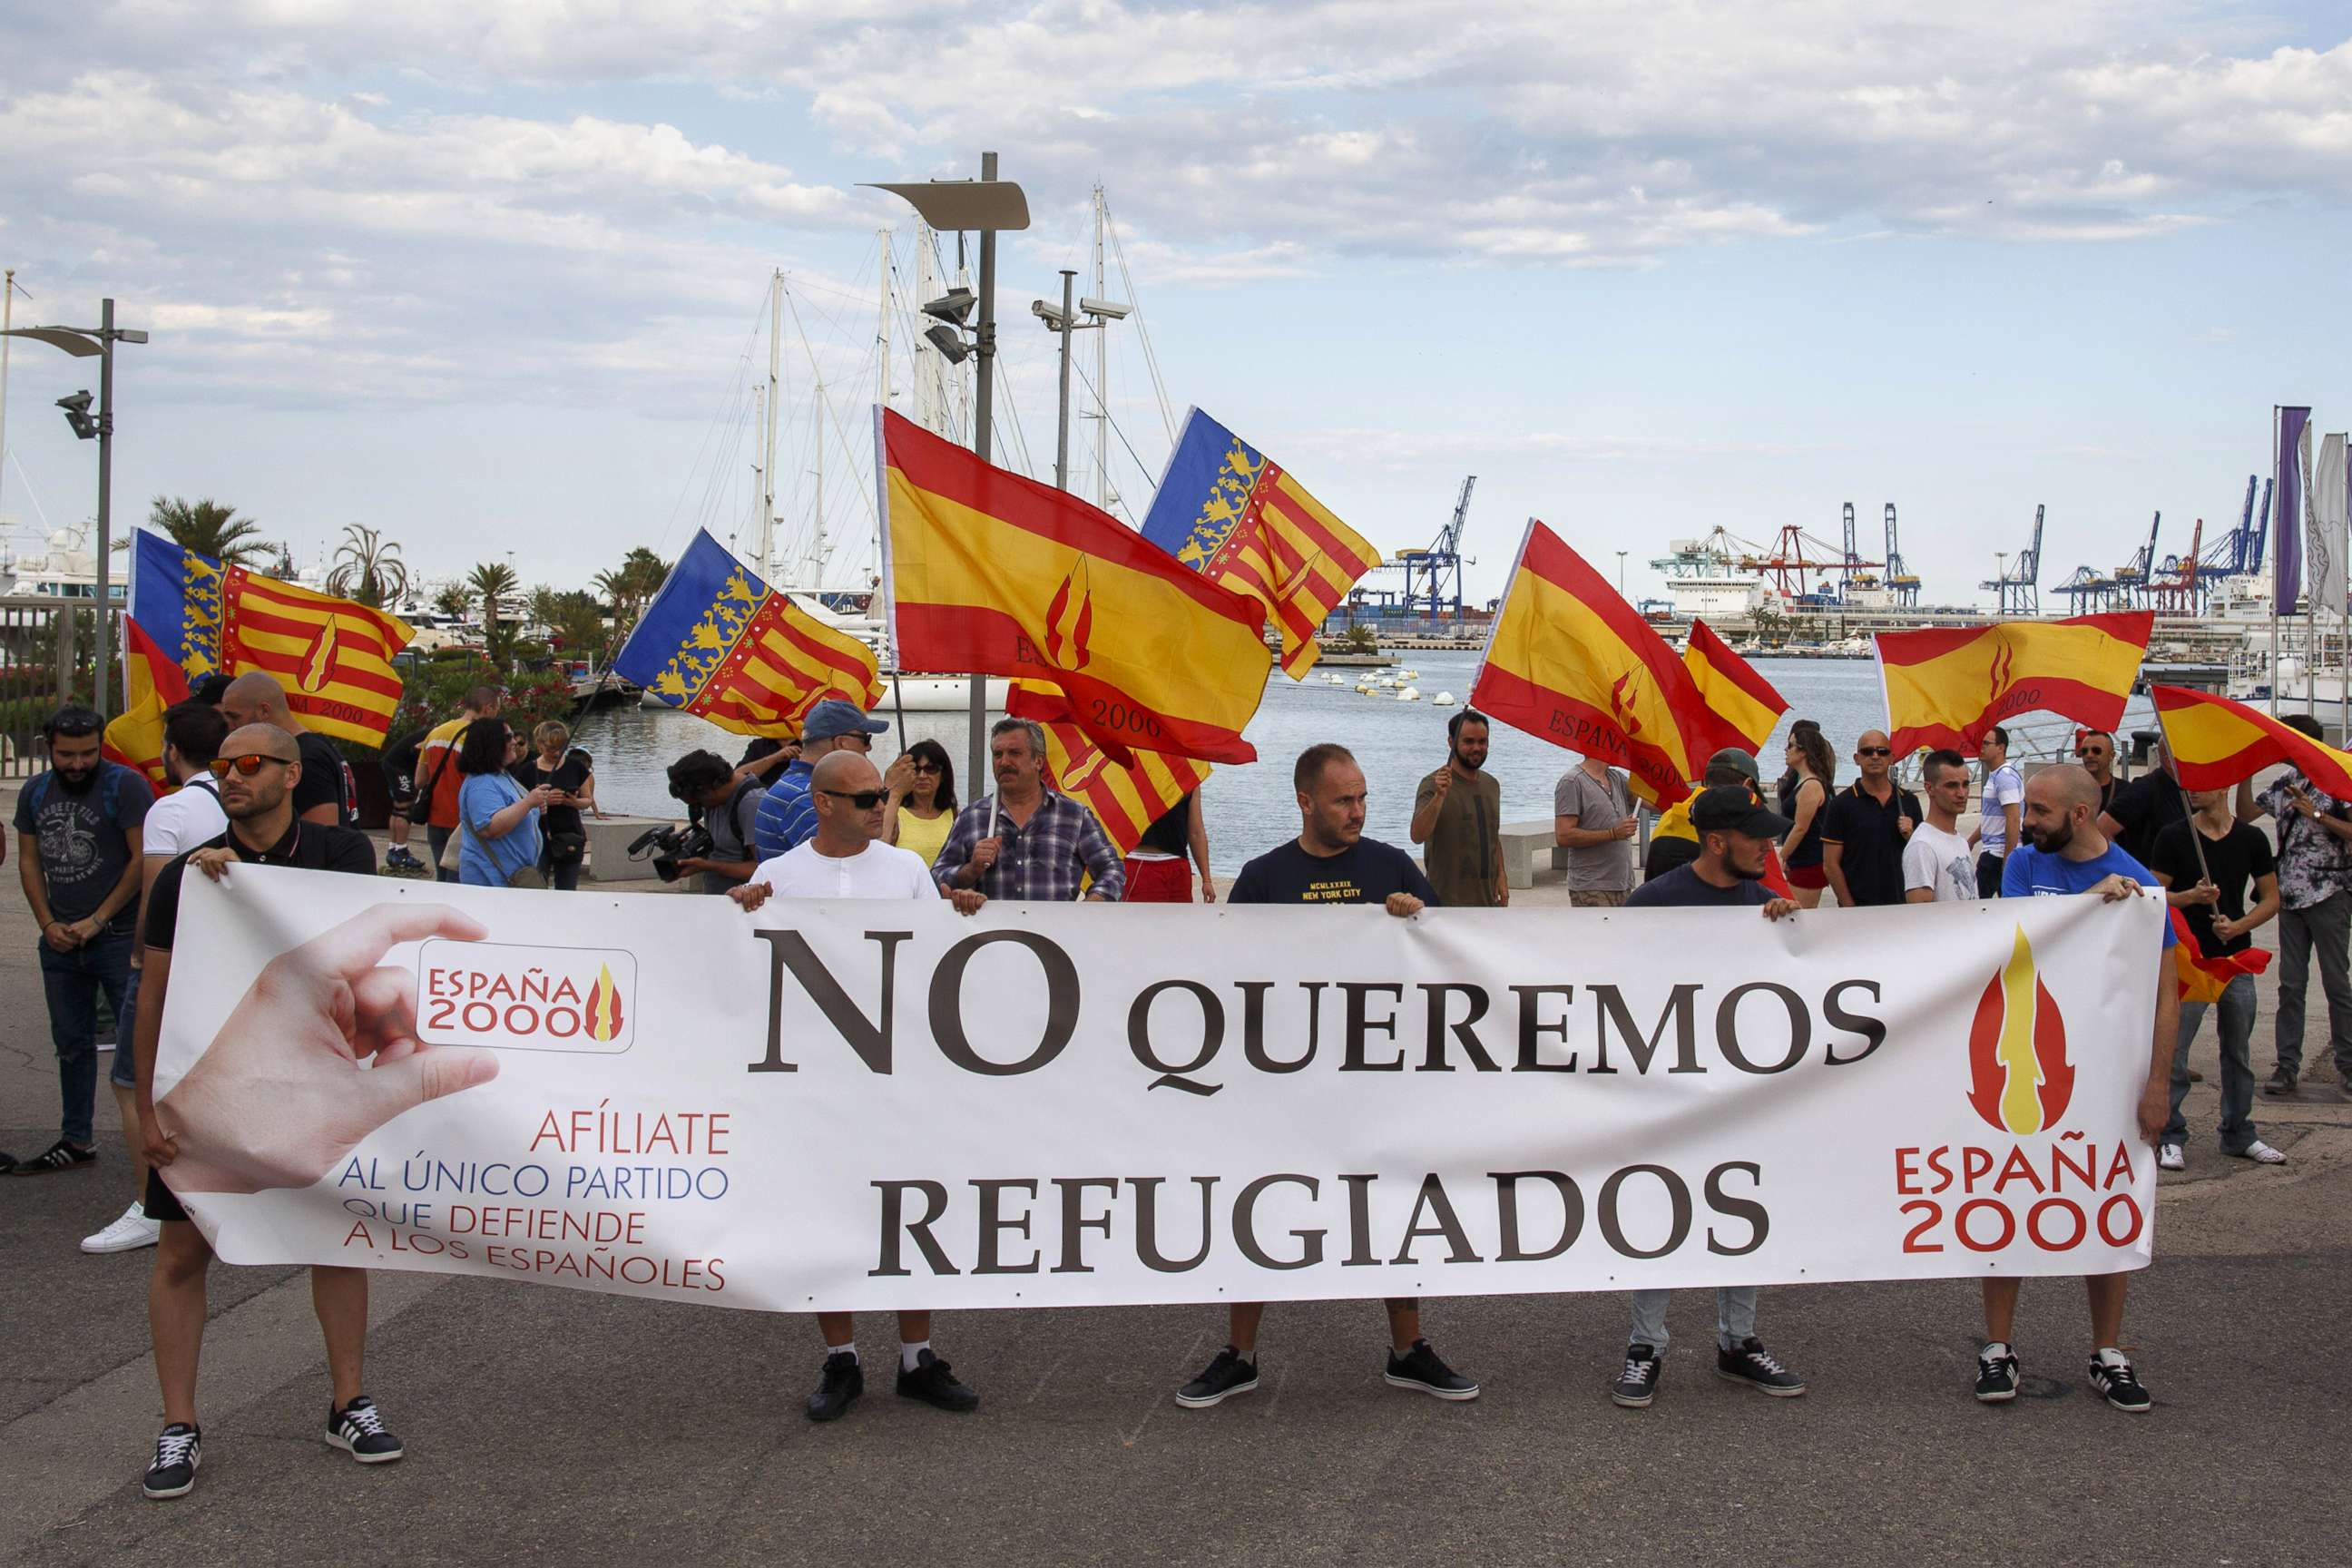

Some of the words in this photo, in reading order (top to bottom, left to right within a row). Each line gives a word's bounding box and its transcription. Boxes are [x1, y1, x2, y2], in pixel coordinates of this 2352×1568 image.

[319, 701, 363, 723] 2000
[1996, 690, 2041, 717] 2000
[1302, 891, 1319, 901] NEW
[1321, 890, 1342, 899] YORK
[1343, 889, 1361, 897] CITY
[428, 968, 582, 1005] ESPAÑA
[428, 999, 581, 1038] 2000
[749, 929, 1080, 1075] NO
[1128, 980, 1887, 1096] QUEREMOS
[530, 1099, 730, 1155] AFÍLIATE
[338, 1156, 386, 1191] AL
[404, 1151, 550, 1198] ÚNICO
[566, 1166, 730, 1200] PARTIDO
[1896, 1131, 2135, 1195] ESPAÑA
[343, 1198, 432, 1230] QUE
[450, 1205, 645, 1245] DEFIENDE
[868, 1161, 1769, 1276] REFUGIADOS
[1898, 1194, 2143, 1253] 2000
[344, 1220, 375, 1249] A
[391, 1228, 469, 1259] LOS
[486, 1246, 725, 1292] ESPAÑOLES
